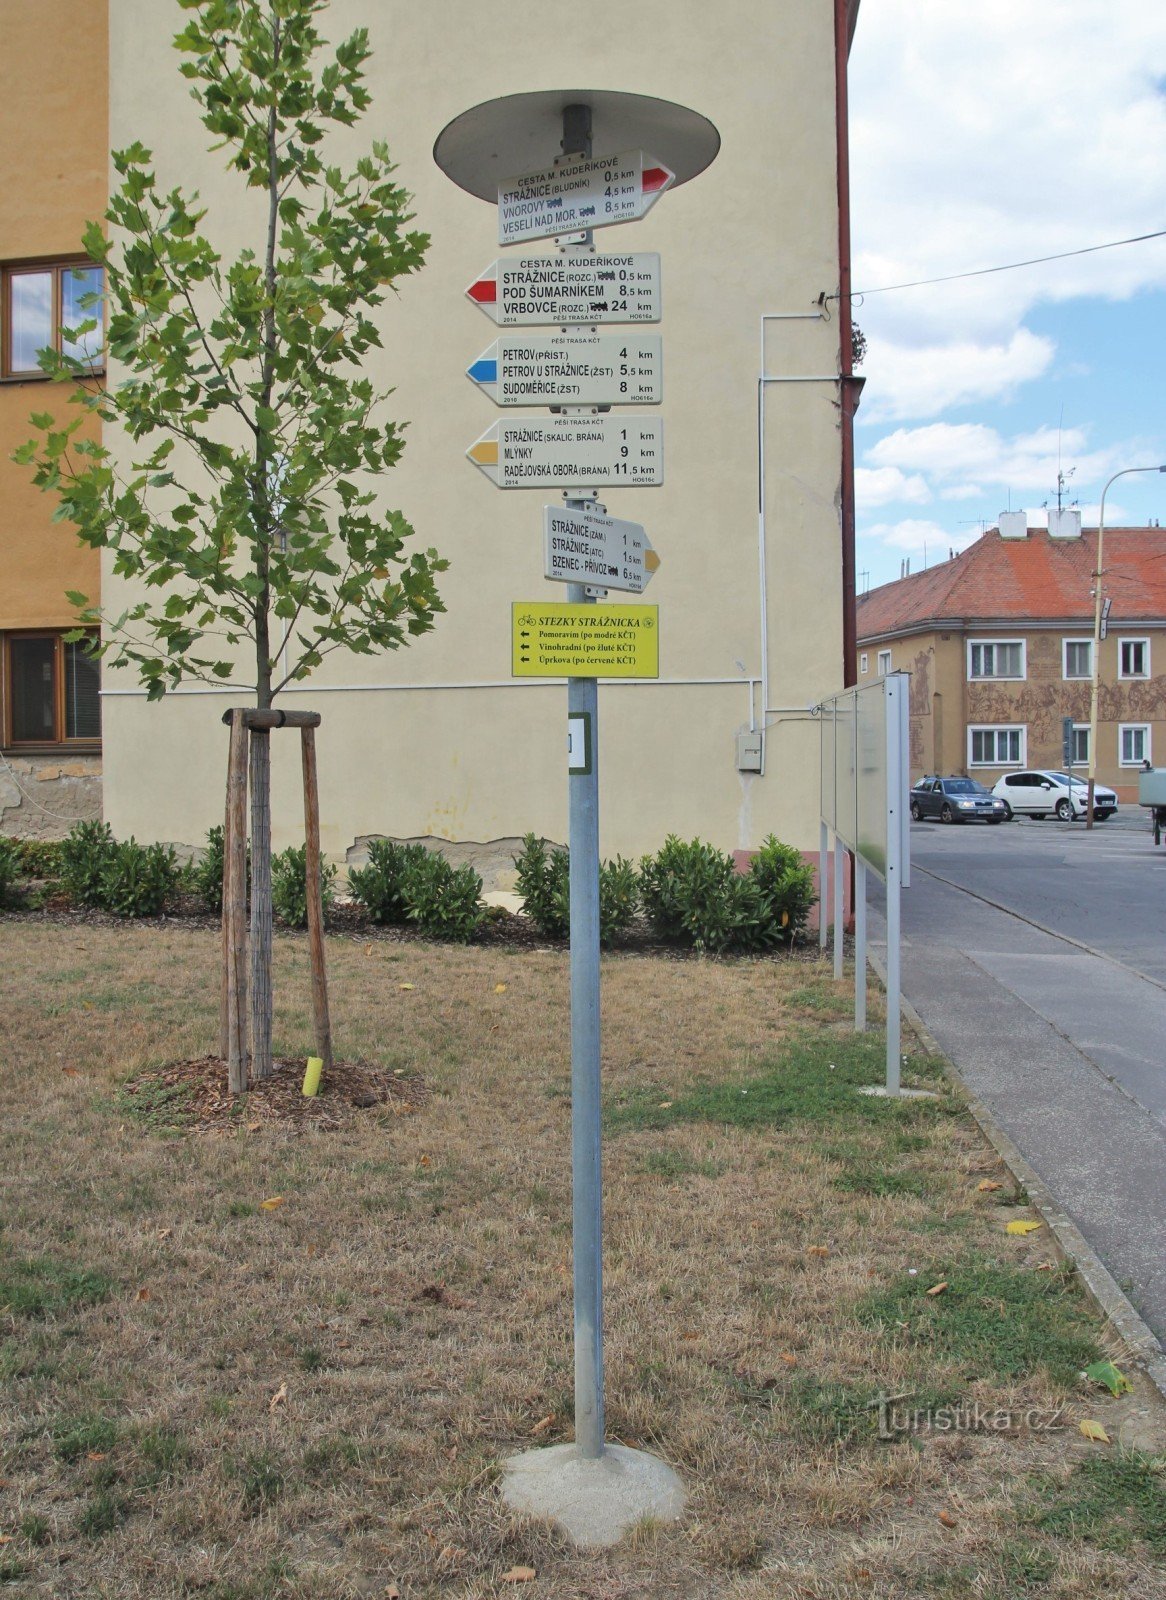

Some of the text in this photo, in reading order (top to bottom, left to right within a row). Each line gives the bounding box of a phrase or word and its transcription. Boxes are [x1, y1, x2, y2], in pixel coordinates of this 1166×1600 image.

[518, 175, 545, 187] CESTA
[560, 158, 618, 177] KUDEŘÍKOVÉ
[504, 170, 634, 204] STRÁŽNICE (BLUDNÍK) 0,5 km
[503, 186, 634, 218] VNOROVY 4,5 km
[503, 201, 634, 233] VESELÍ NAD MOR. 8,5 km
[569, 257, 633, 266] KUDEŘÍKOVÉ
[503, 270, 564, 283] STRÁŽNICE
[566, 273, 596, 283] (ROZC.)
[619, 270, 634, 281] 0,5
[503, 288, 526, 298] POD
[530, 284, 604, 298] ŠUMARNÍKEM
[619, 285, 635, 296] 8,5
[504, 302, 557, 313] VRBOVCE
[558, 304, 589, 313] (ROZC.)
[611, 300, 627, 311] 24
[503, 349, 535, 360] PETROV
[619, 348, 627, 358] 4
[503, 366, 535, 377] PETROV
[537, 366, 542, 376] U
[545, 363, 589, 376] STRÁŽNICE
[590, 367, 613, 377] (ŽST)
[620, 364, 635, 376] 5,5
[503, 380, 556, 394] SUDOMĚŘICE
[557, 385, 580, 395] (ŽST)
[620, 382, 627, 392] 8
[504, 428, 543, 442] STRÁŽNICE
[544, 433, 574, 443] (SKALIC.
[576, 432, 604, 442] BRÁNA)
[621, 429, 627, 440] 1
[505, 446, 532, 459] MLÝNKY
[620, 446, 628, 457] 9
[505, 462, 551, 476] RADĚJOVSKÁ
[553, 464, 578, 475] OBORA
[579, 466, 610, 476] (BRÁNA)
[552, 519, 589, 538] STRÁŽNICE
[623, 535, 627, 545] 1
[552, 537, 589, 555] STRÁŽNICE
[552, 555, 580, 570] BZENEC
[585, 559, 607, 575] PŘÍVOZ
[539, 616, 640, 627] STEZKY STRÁŽNICKA
[580, 630, 592, 640] (po
[594, 630, 616, 638] modré
[618, 629, 636, 640] KČT)
[539, 643, 581, 651] Vinohradní
[583, 643, 595, 652] (po
[617, 642, 636, 652] KČT)
[572, 656, 584, 665] (po
[617, 655, 636, 665] KČT)
